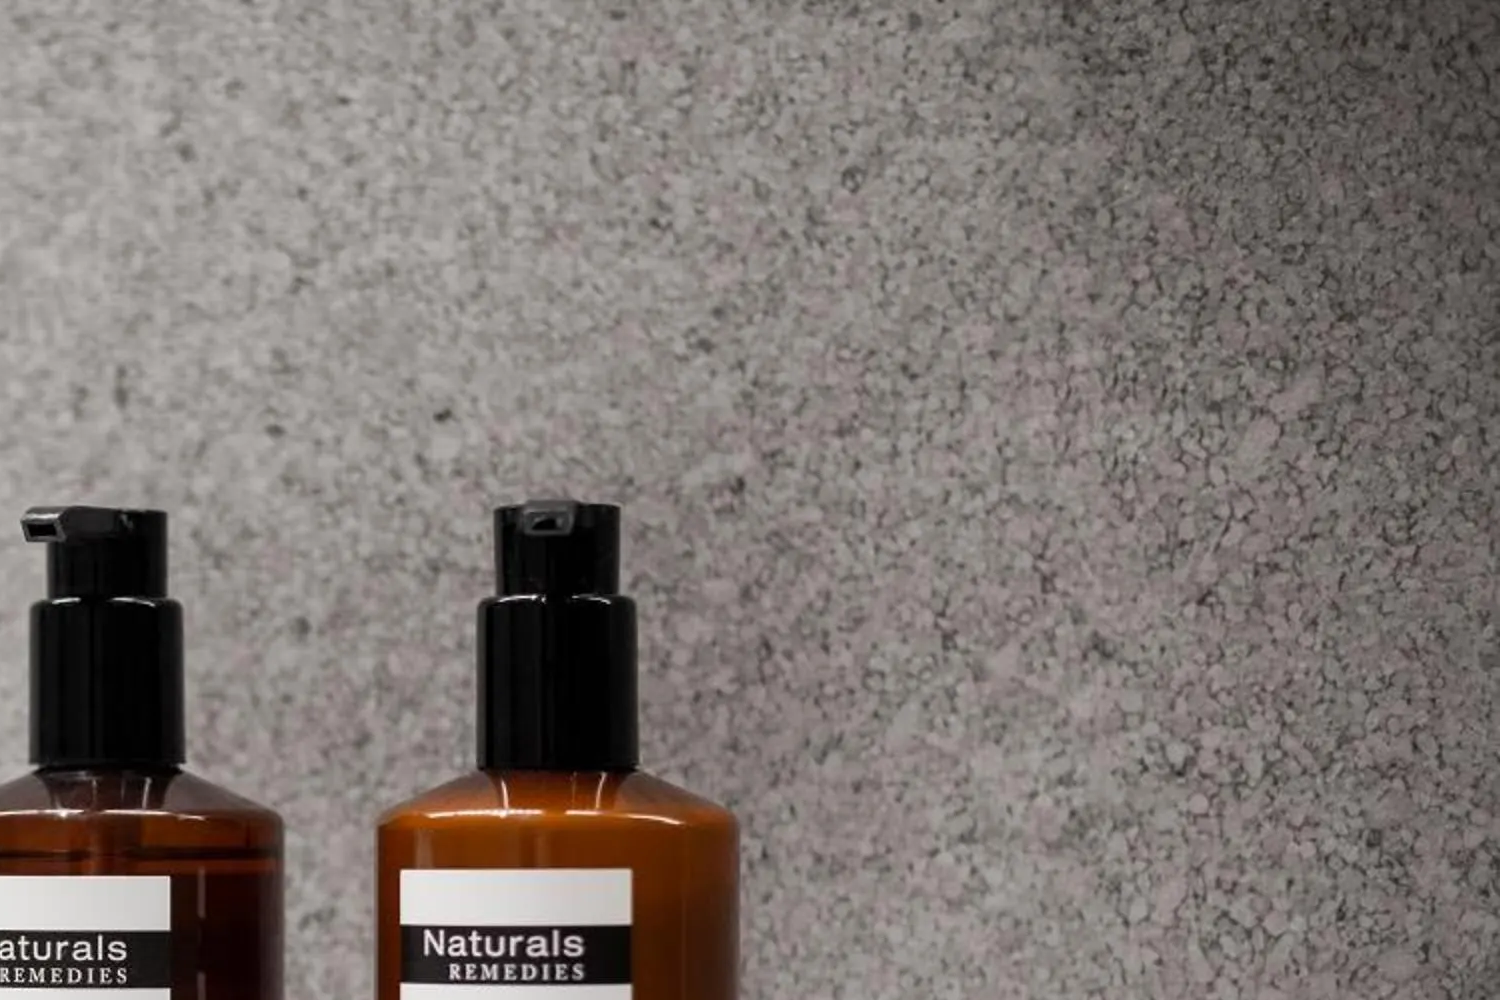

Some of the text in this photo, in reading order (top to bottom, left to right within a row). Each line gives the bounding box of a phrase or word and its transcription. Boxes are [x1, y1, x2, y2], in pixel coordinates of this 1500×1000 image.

[423, 929, 584, 957] Naturals
[0, 967, 128, 984] REMEDIES
[449, 963, 585, 981] REMEDIES
